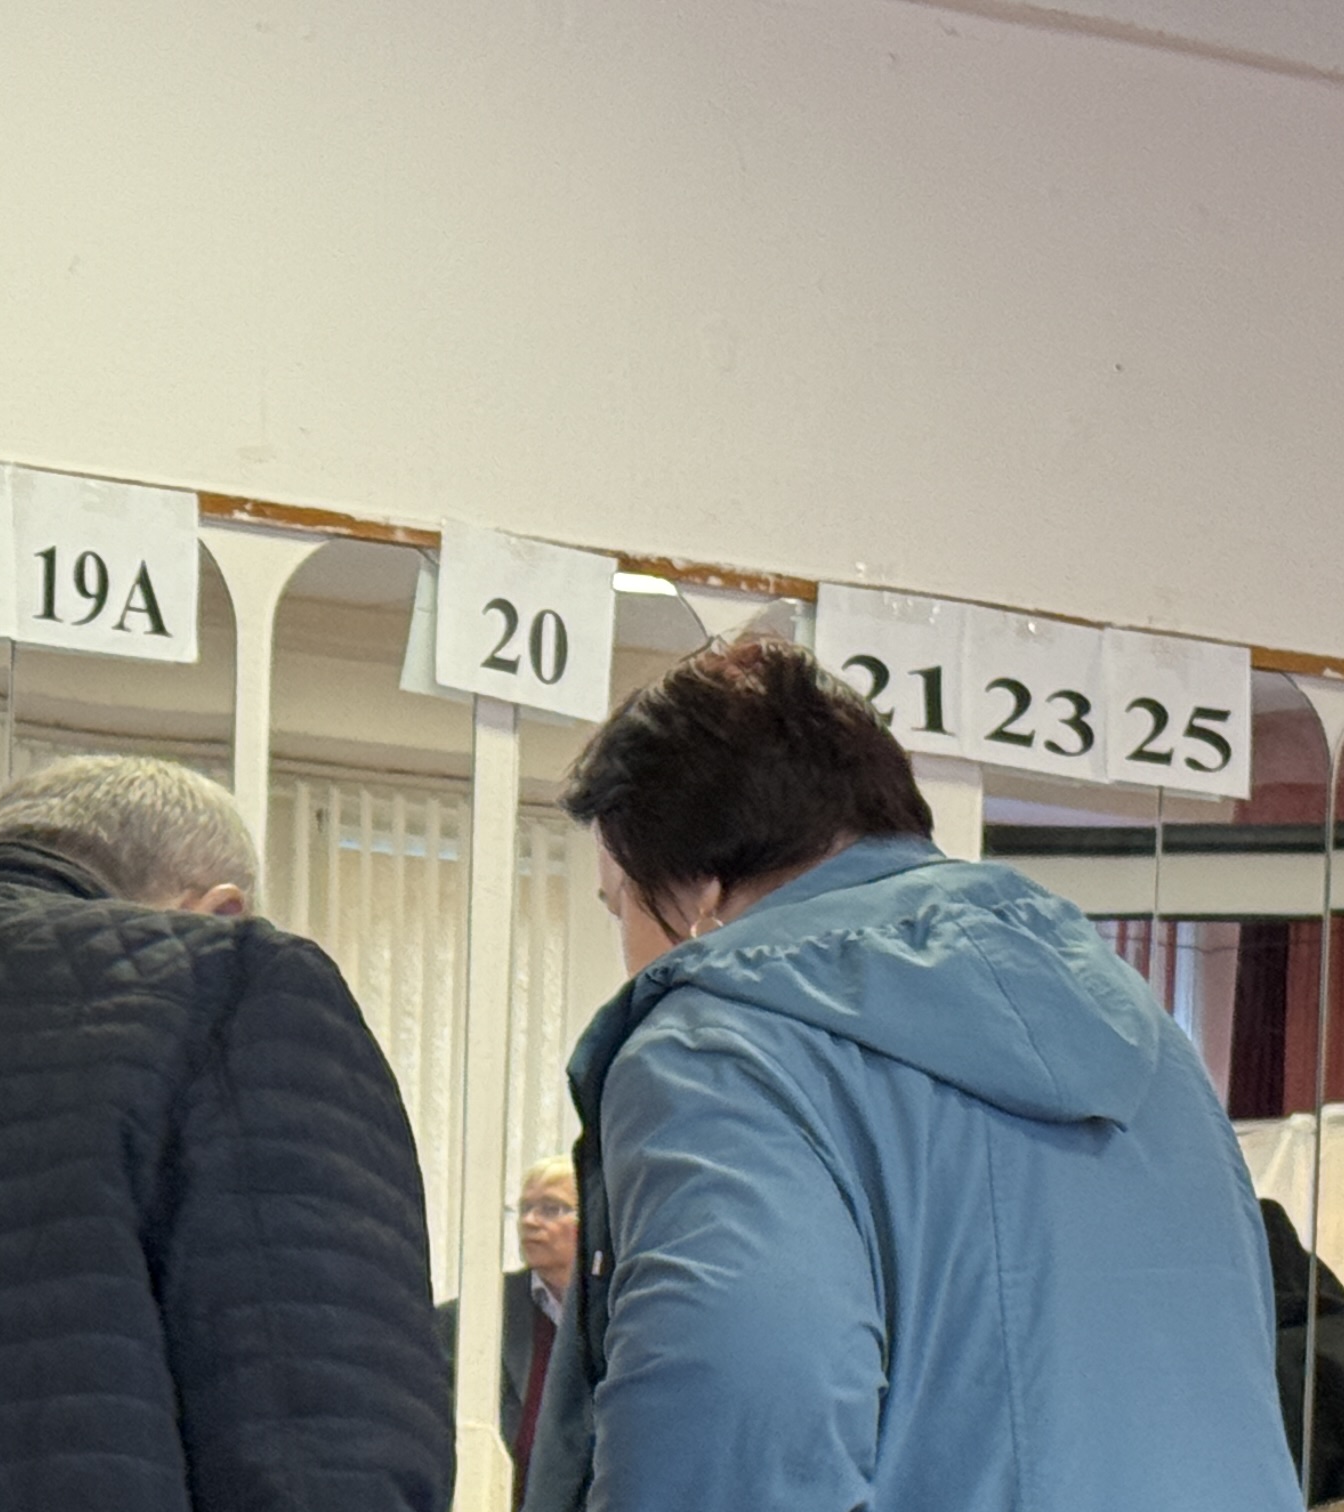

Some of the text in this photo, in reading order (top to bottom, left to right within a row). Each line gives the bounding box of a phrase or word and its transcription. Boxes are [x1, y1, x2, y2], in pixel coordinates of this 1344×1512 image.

[34, 546, 174, 638] 19А
[480, 597, 569, 686] 20
[841, 654, 957, 737] 21
[983, 677, 1096, 758] 23
[1124, 697, 1233, 773] 25
